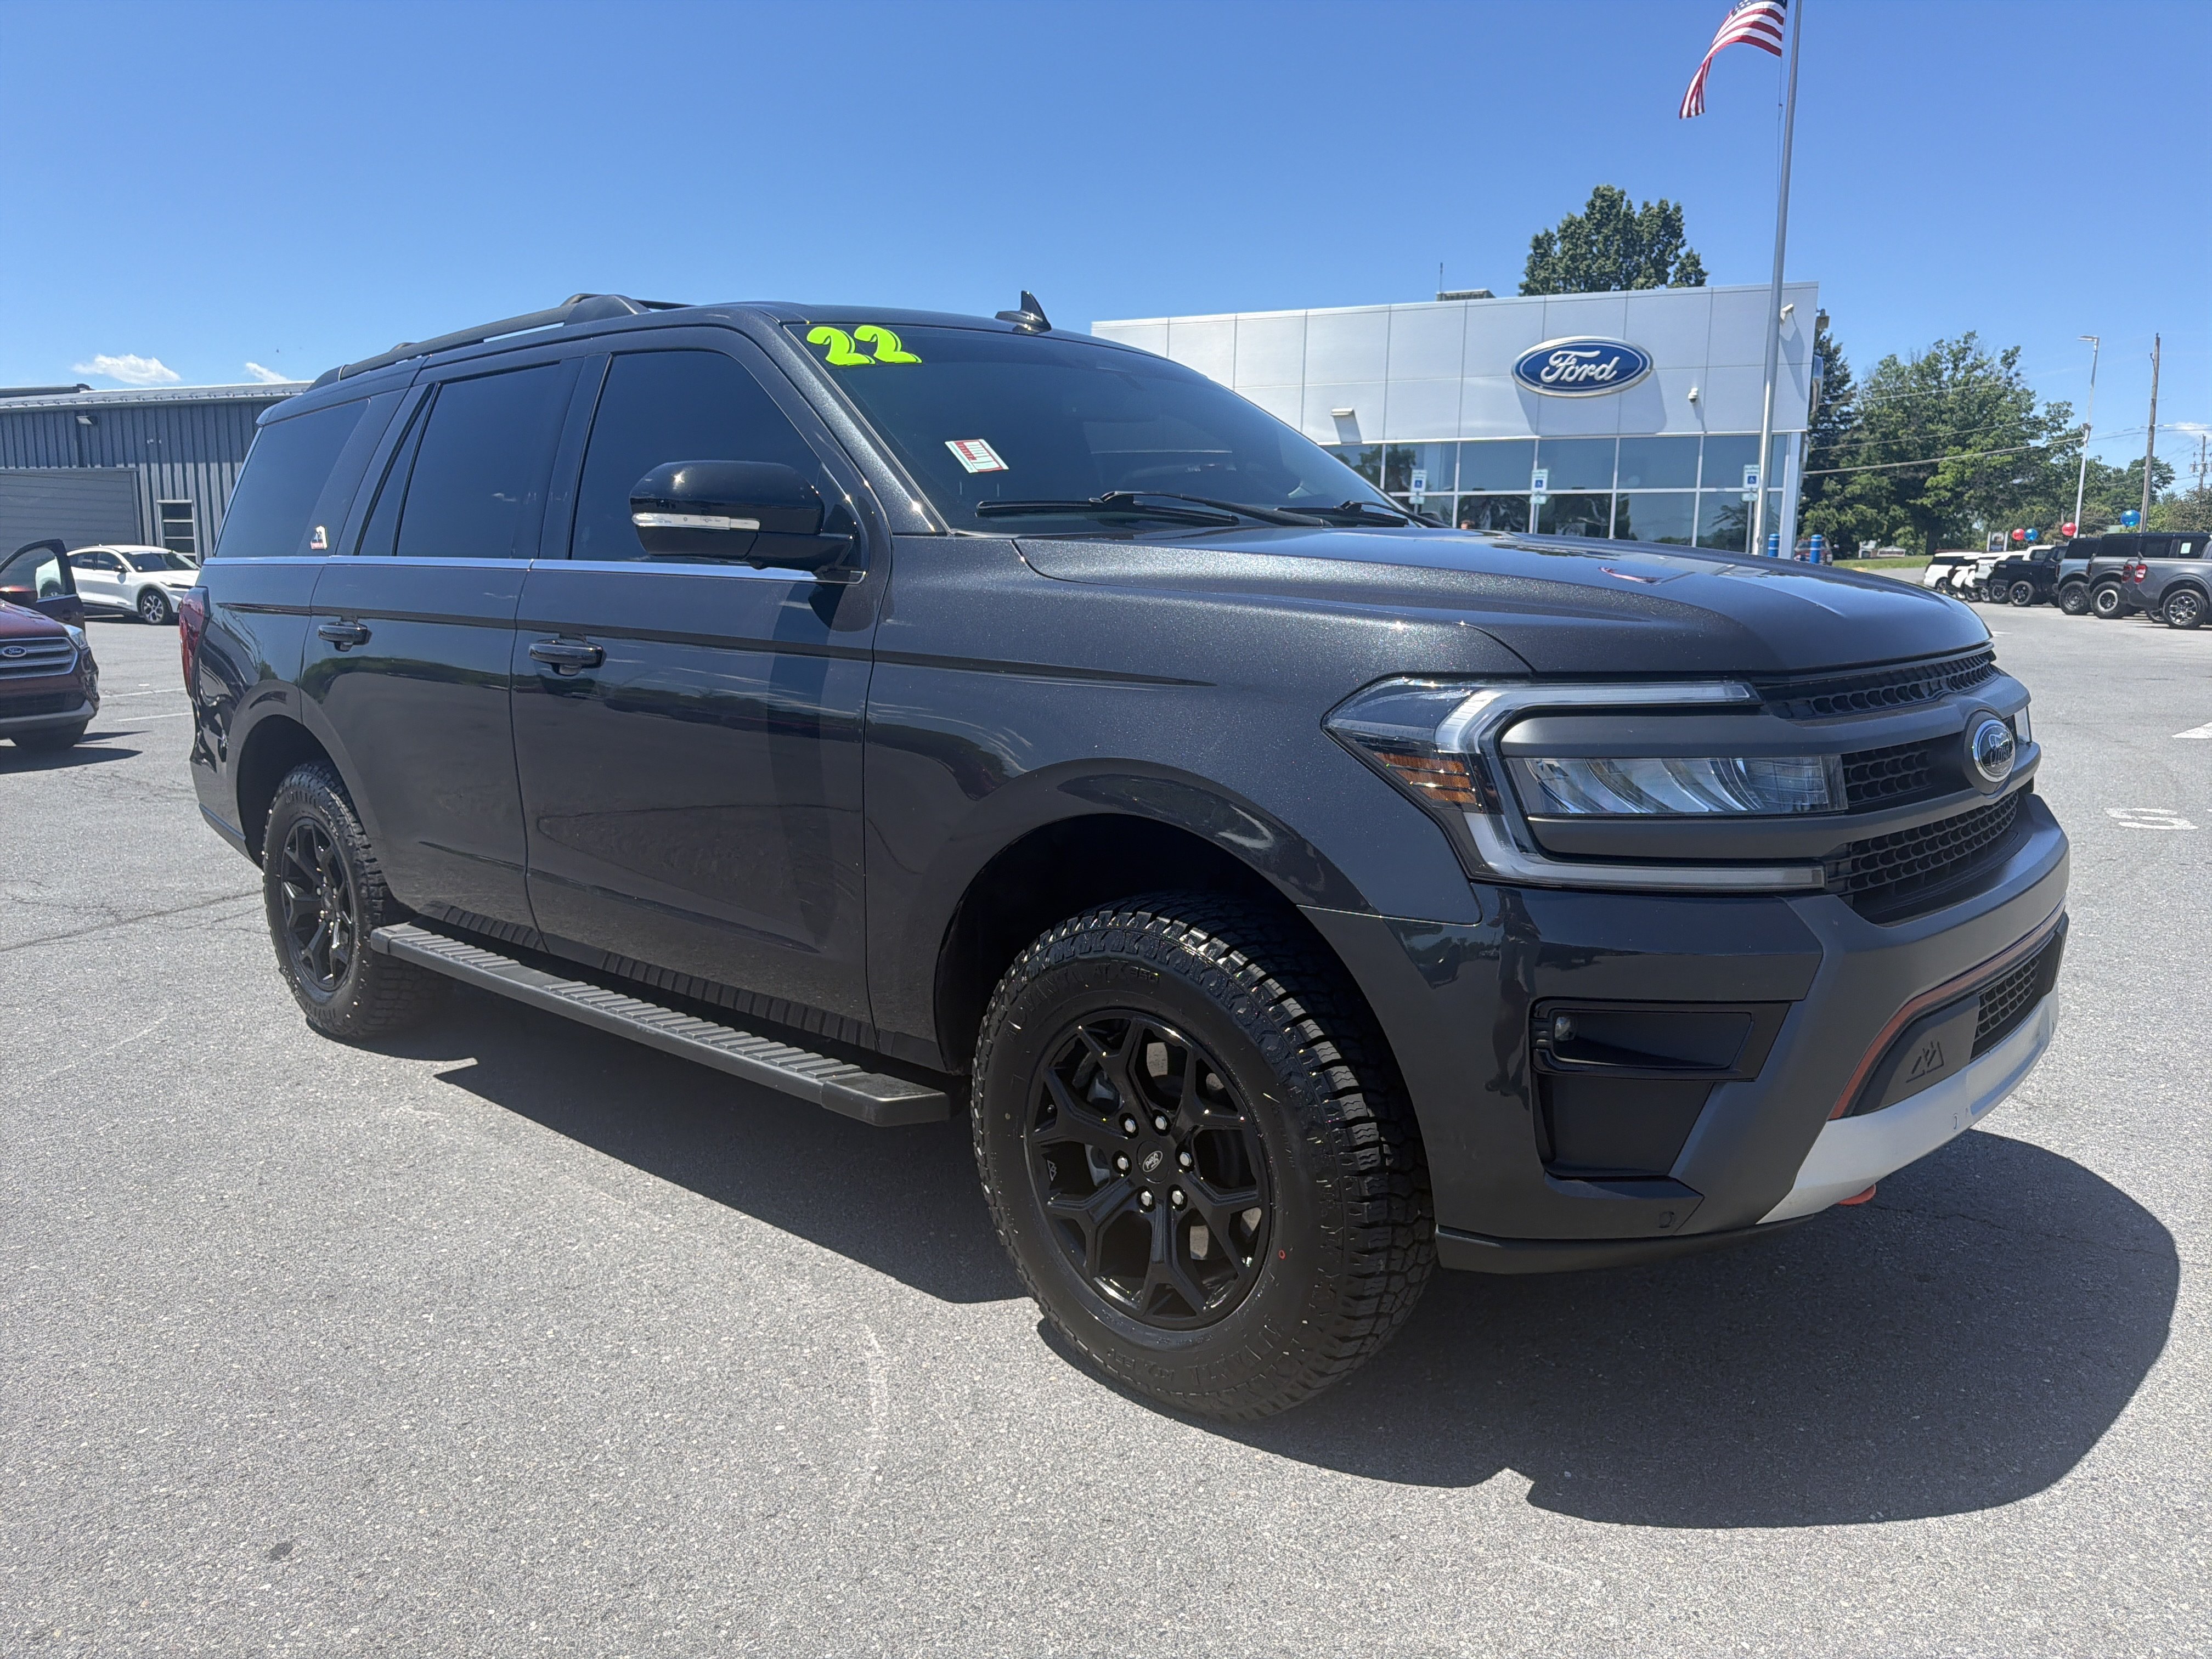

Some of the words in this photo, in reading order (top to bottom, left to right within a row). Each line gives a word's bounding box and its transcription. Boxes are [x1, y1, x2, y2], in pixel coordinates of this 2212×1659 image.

[806, 325, 923, 366] 22
[1540, 350, 1620, 383] Ford
[1145, 1153, 1159, 1170] Ford
